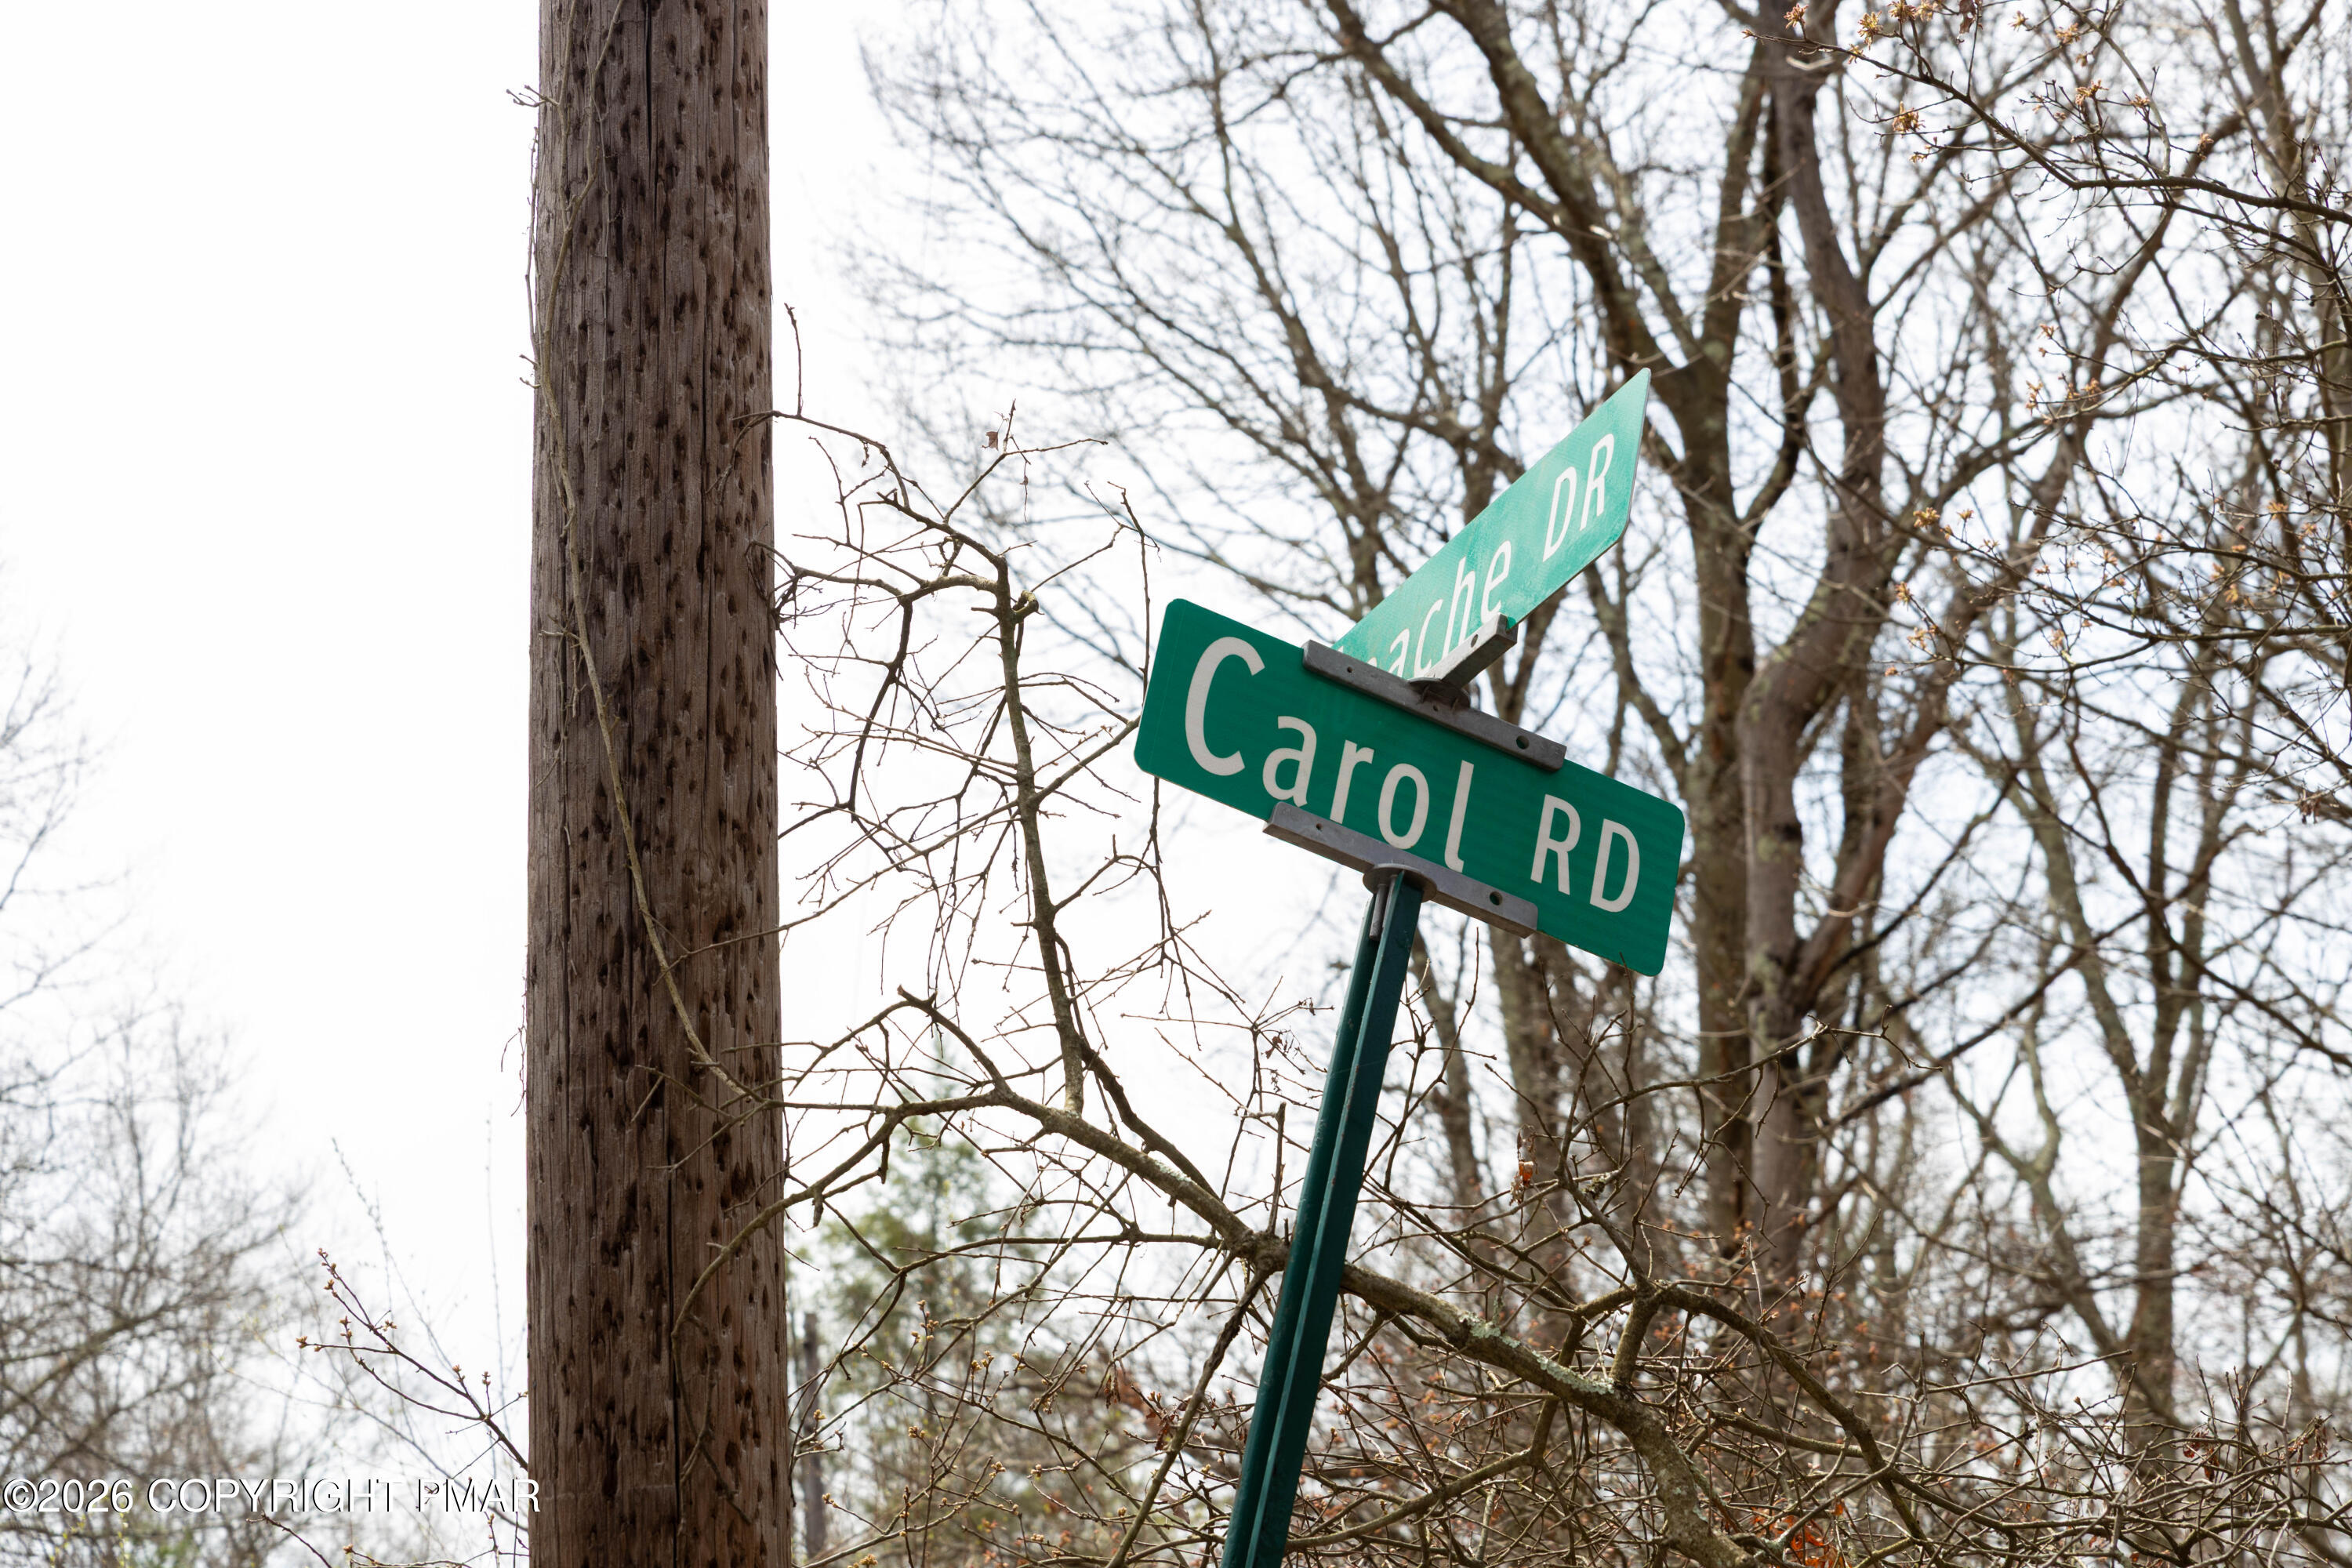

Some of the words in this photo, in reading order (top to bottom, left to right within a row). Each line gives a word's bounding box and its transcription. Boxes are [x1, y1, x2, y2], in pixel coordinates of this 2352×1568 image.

[1338, 540, 1512, 680] ache
[1543, 433, 1615, 563] DR
[1185, 636, 1475, 873] Carol
[1530, 794, 1641, 913] RD
